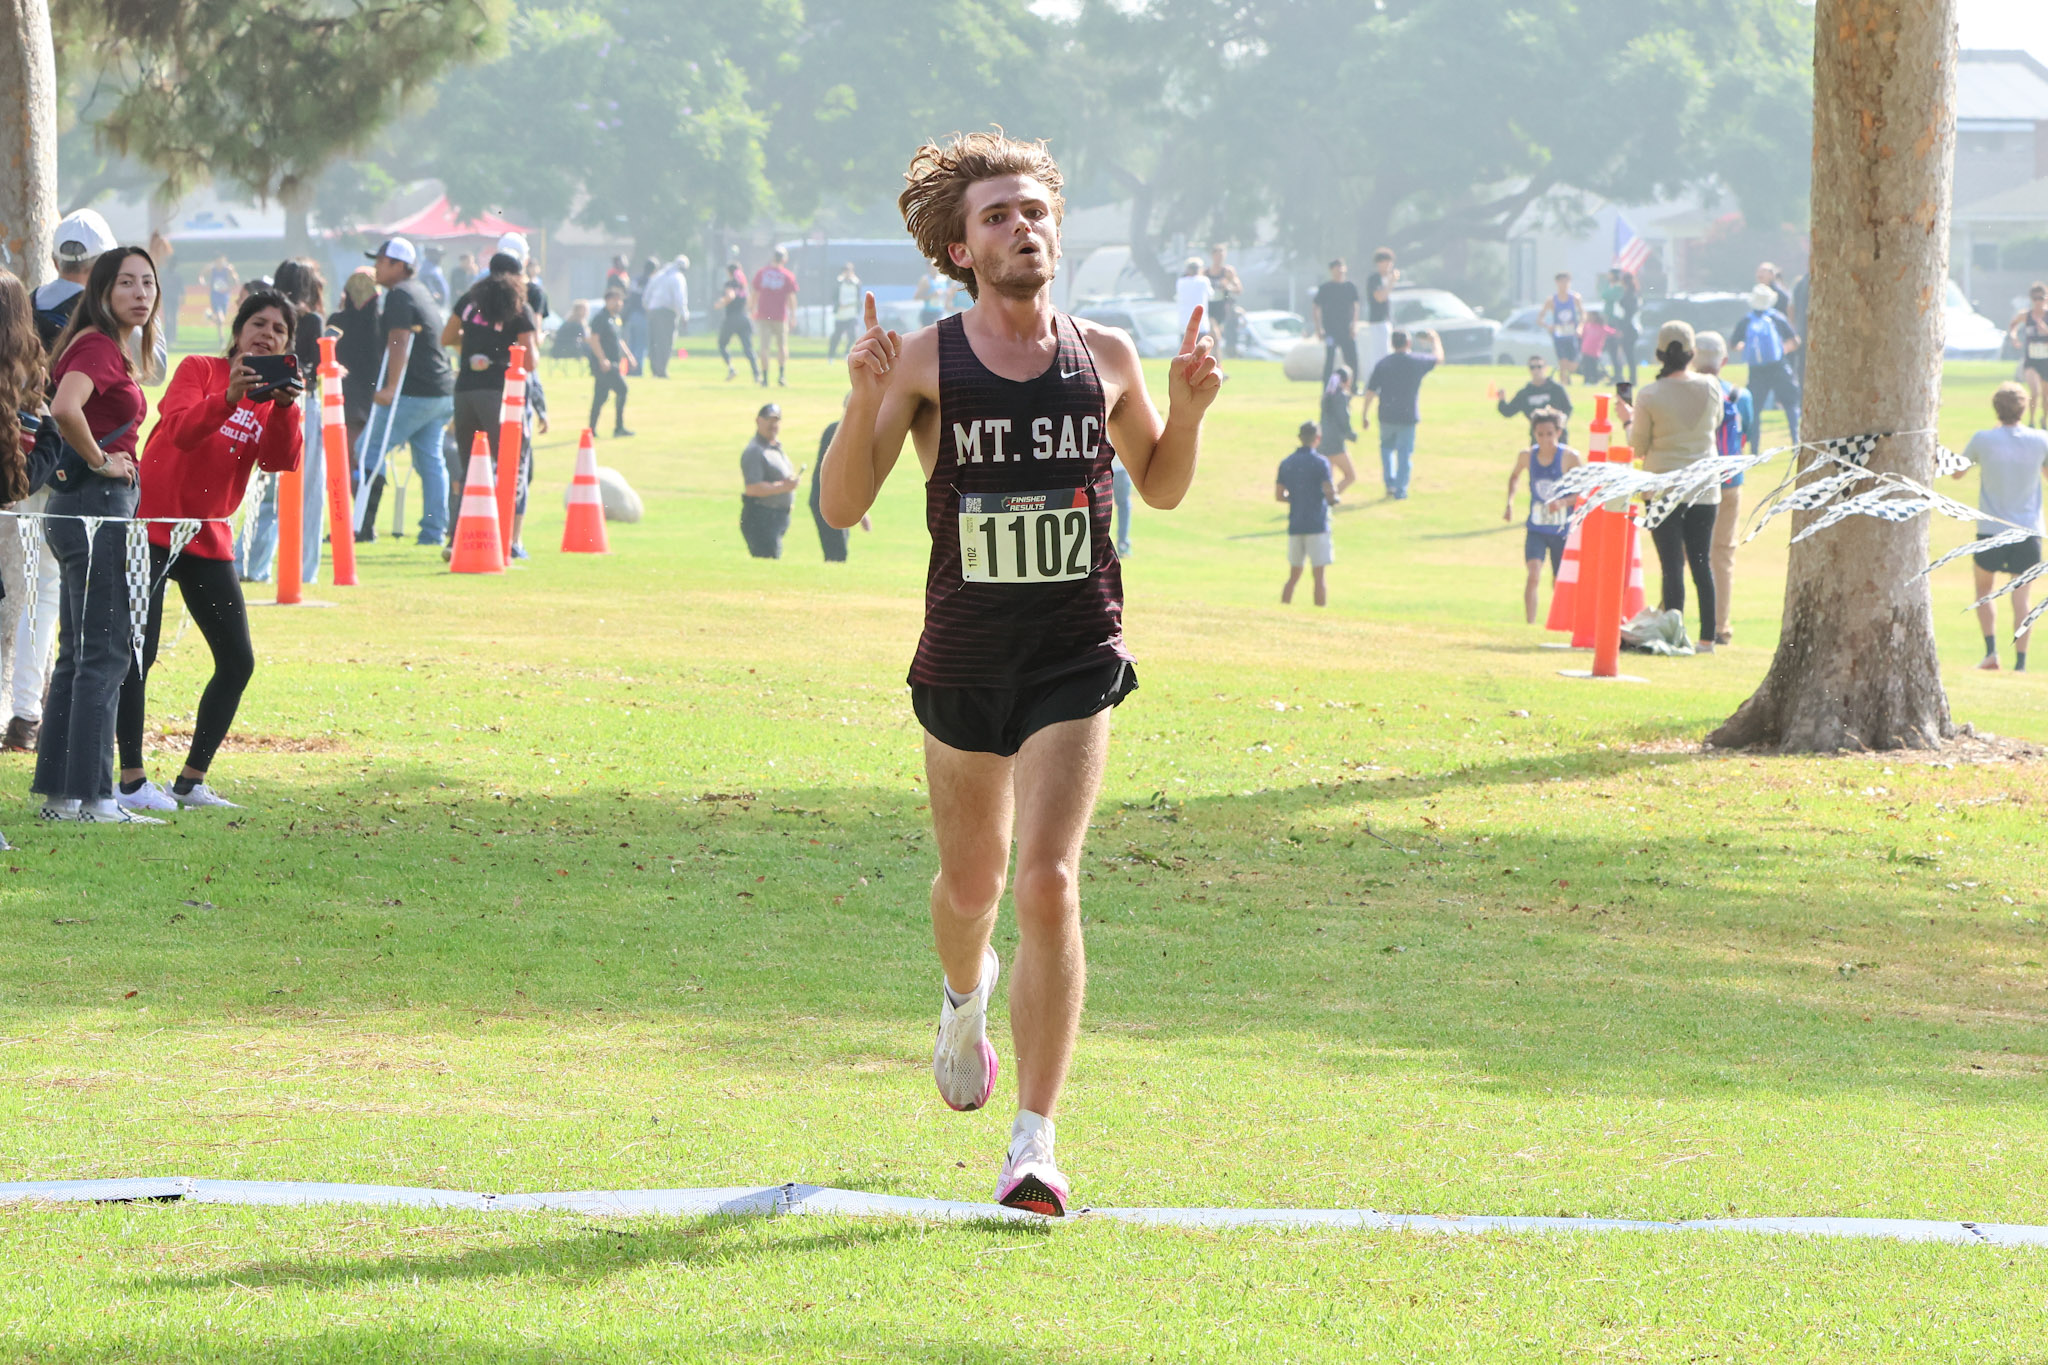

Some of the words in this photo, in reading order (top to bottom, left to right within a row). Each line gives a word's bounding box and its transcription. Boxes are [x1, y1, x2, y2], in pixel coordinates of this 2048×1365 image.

[953, 419, 1021, 466] MT.
[1031, 415, 1099, 460] SAC
[1009, 503, 1046, 511] RESULTS
[1011, 495, 1047, 503] FINISHED
[979, 511, 1087, 578] 1102
[967, 547, 977, 568] 1102
